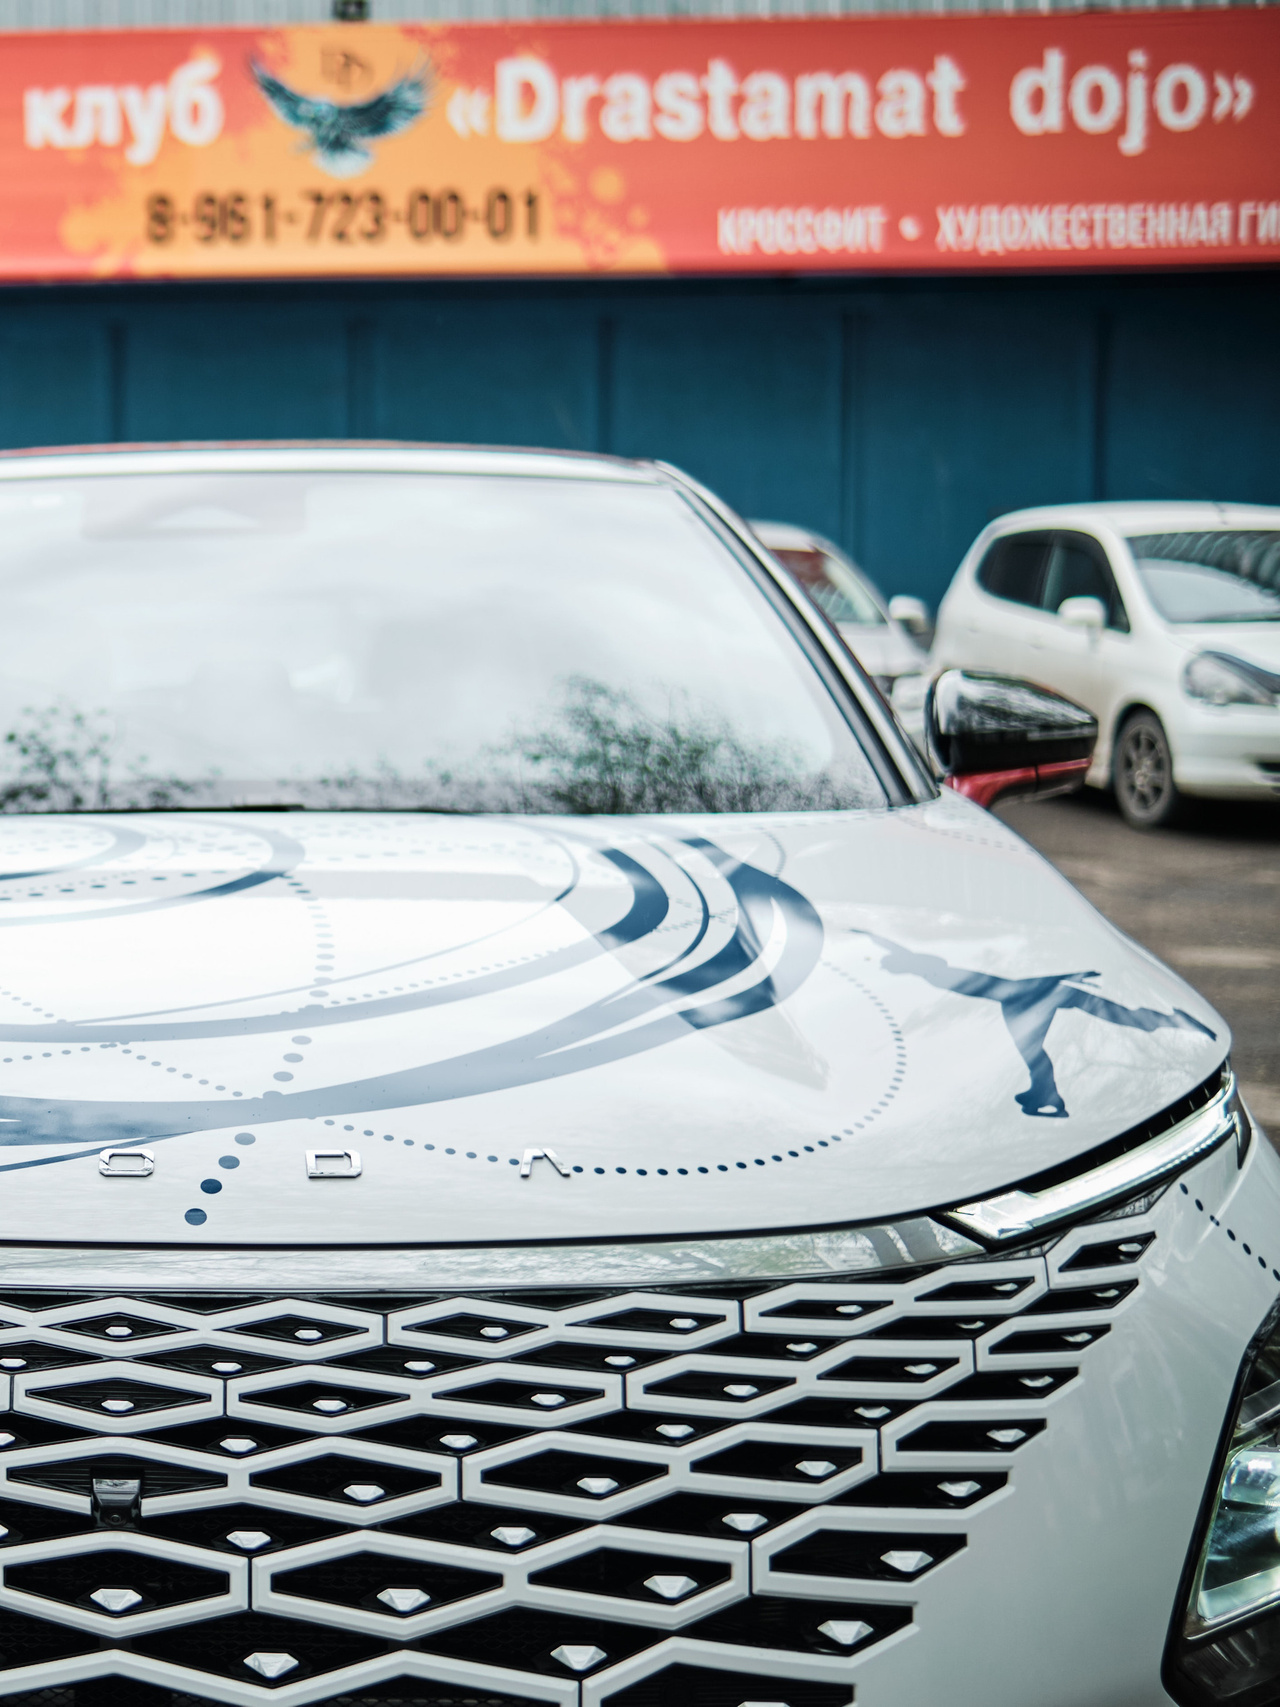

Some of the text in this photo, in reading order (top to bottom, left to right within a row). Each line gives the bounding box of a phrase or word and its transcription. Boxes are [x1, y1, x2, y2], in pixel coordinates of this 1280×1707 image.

[24, 54, 224, 166] клуб
[447, 54, 966, 144] «Drastamat
[1010, 47, 1254, 156] dojo»
[145, 189, 542, 245] 8-961-723-00-01
[717, 206, 886, 254] КРОССФИТ
[935, 202, 1231, 256] ХУДОЖЕСТВЕННАЯ
